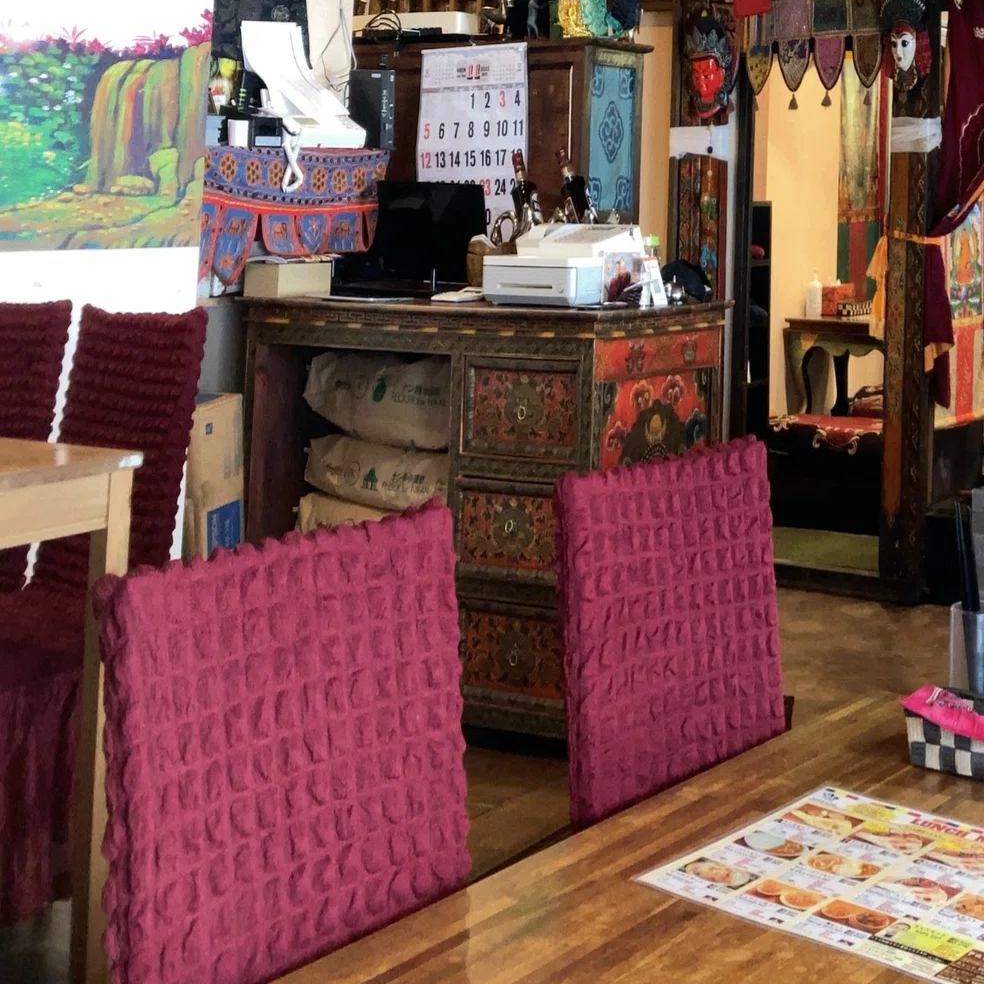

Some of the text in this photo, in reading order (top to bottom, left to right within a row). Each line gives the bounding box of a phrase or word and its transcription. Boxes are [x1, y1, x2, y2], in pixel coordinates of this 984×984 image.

[470, 90, 521, 109] 1 2 3 4
[423, 119, 523, 140] 5 6 7 8 9 10 11
[420, 149, 506, 169] 12 13 14 15 16 17
[494, 178, 506, 195] 24
[910, 818, 969, 838] LUNCH
